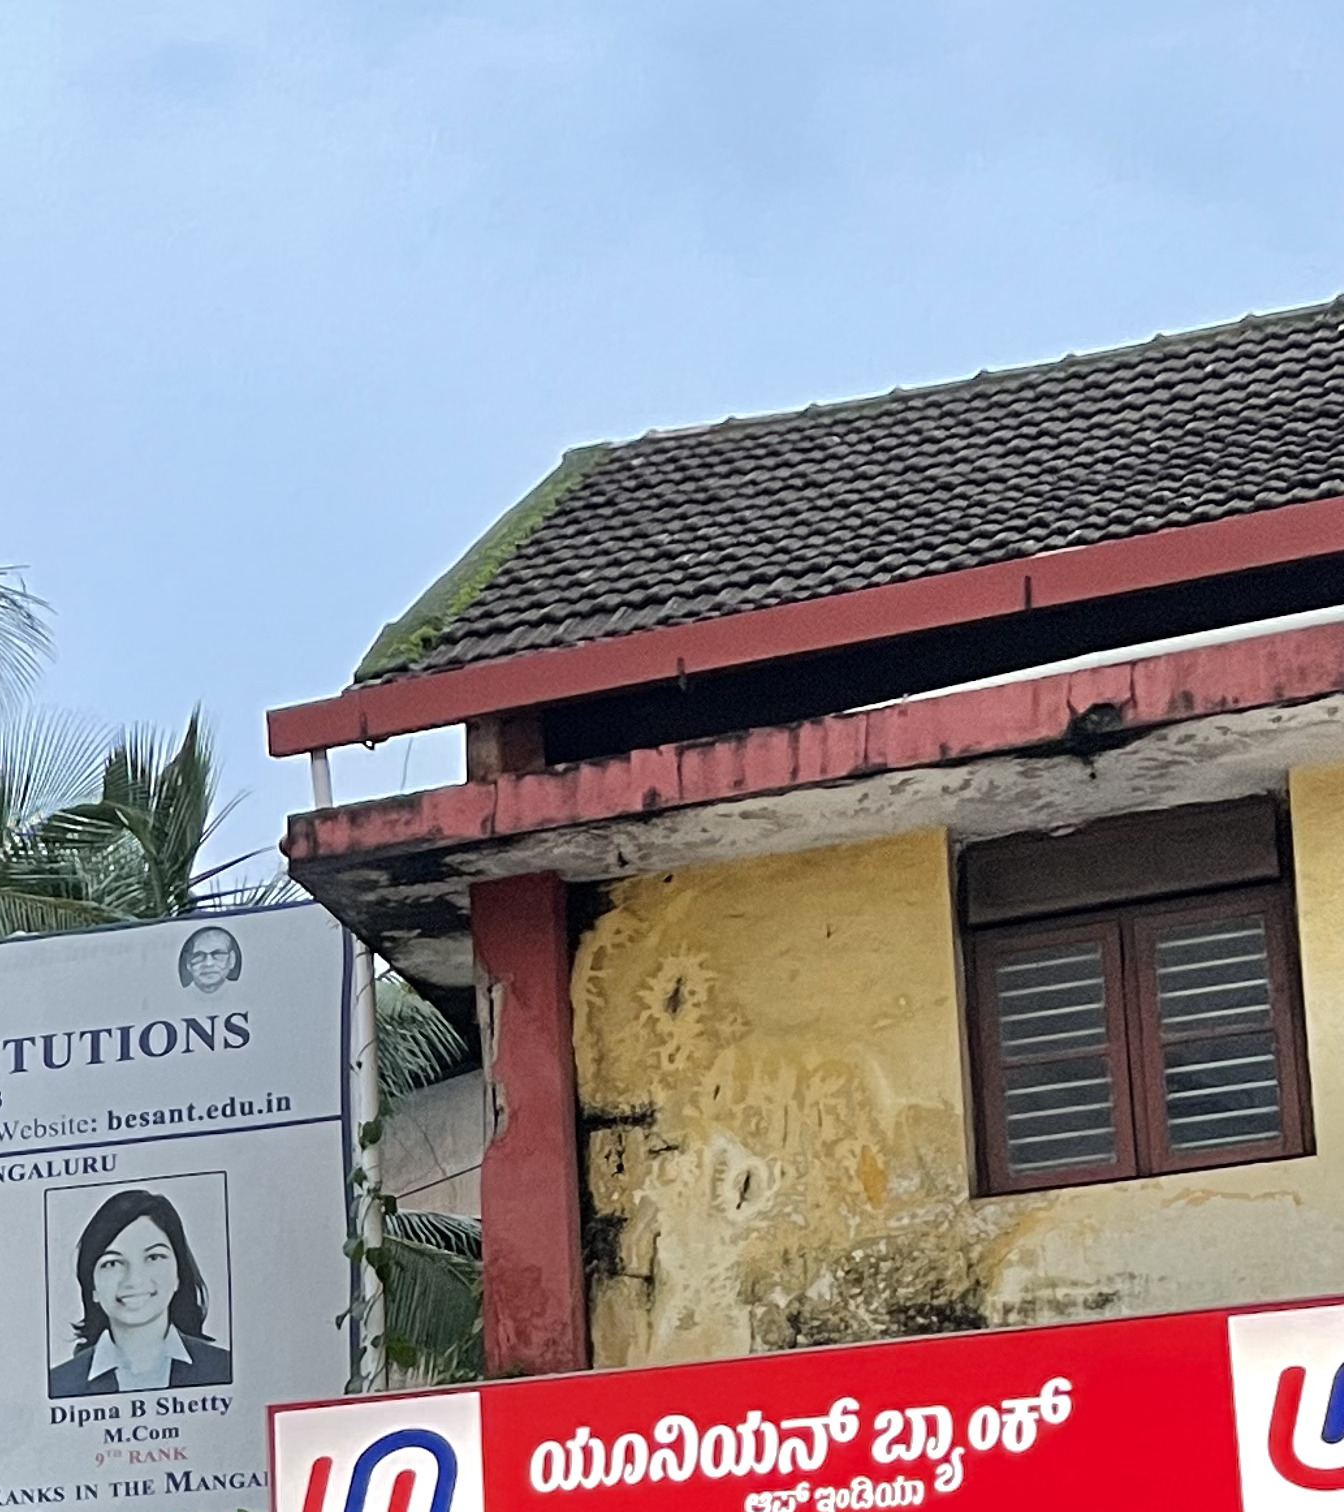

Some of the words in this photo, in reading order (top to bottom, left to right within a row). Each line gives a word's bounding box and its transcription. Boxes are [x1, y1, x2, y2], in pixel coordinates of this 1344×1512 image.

[106, 1091, 293, 1132] besant.edu.in
[50, 1405, 120, 1426] Dipna
[131, 1401, 146, 1418] B
[156, 1395, 233, 1420] Shetty
[103, 1424, 180, 1444] M.Com
[529, 1396, 861, 1494] ಯೂನಿಯನ್
[128, 1445, 188, 1464] RANK
[75, 1483, 99, 1501] IN
[108, 1479, 156, 1498] THE
